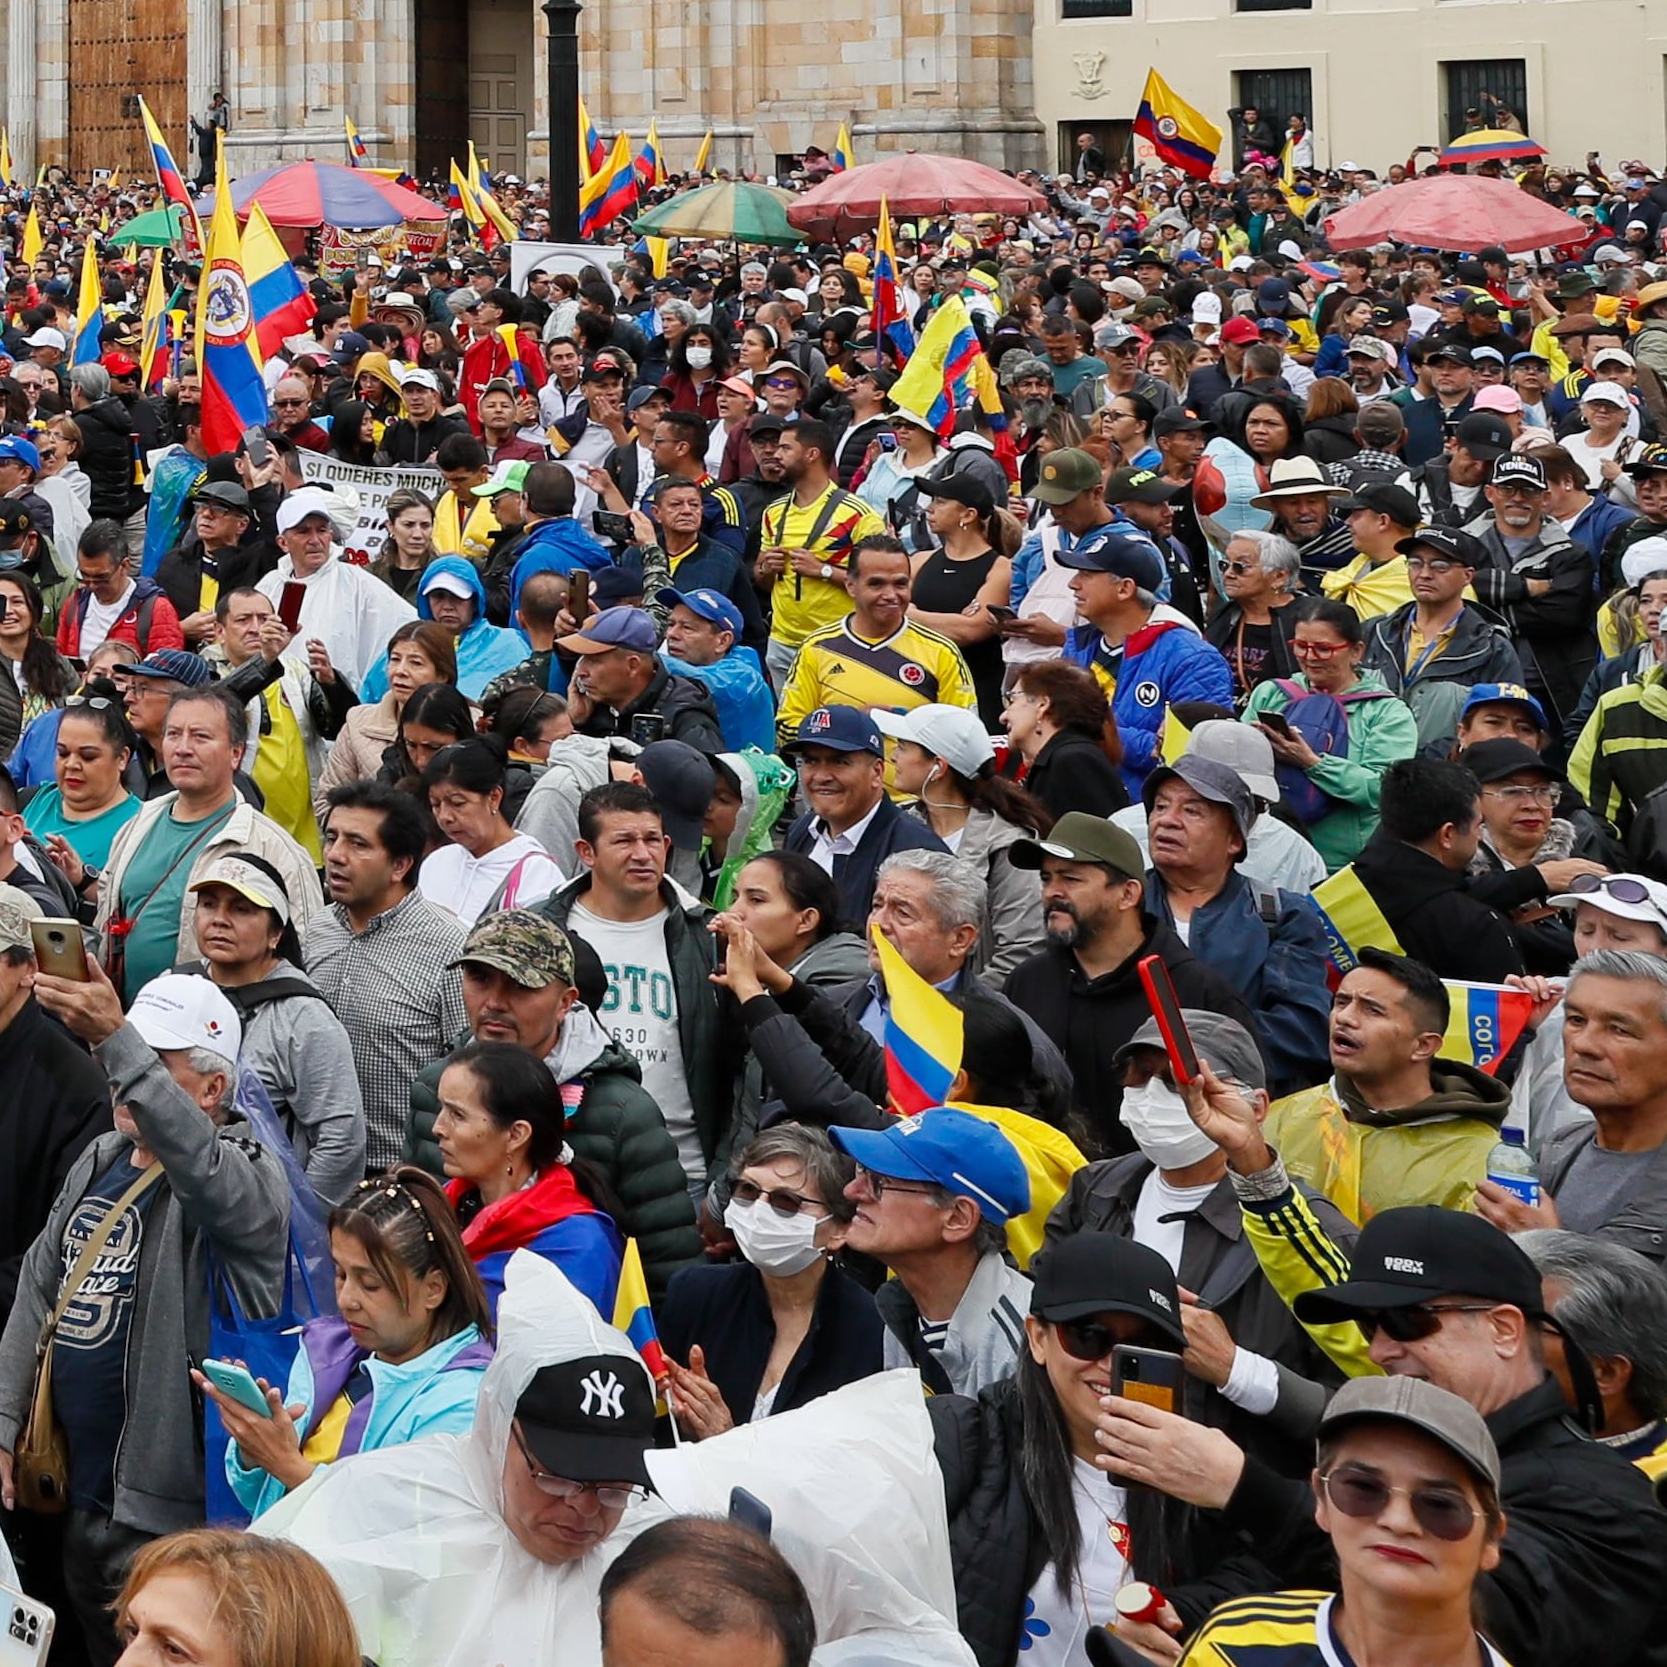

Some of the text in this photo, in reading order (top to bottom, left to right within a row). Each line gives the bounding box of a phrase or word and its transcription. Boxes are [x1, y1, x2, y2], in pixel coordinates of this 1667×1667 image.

[305, 461, 322, 478] SI
[325, 465, 393, 487] QUIERES
[1499, 461, 1539, 476] VENEZIA
[601, 965, 673, 1021] STO
[1384, 1256, 1424, 1267] BODY
[1386, 1264, 1424, 1275] TECH
[580, 1370, 625, 1419] NY
